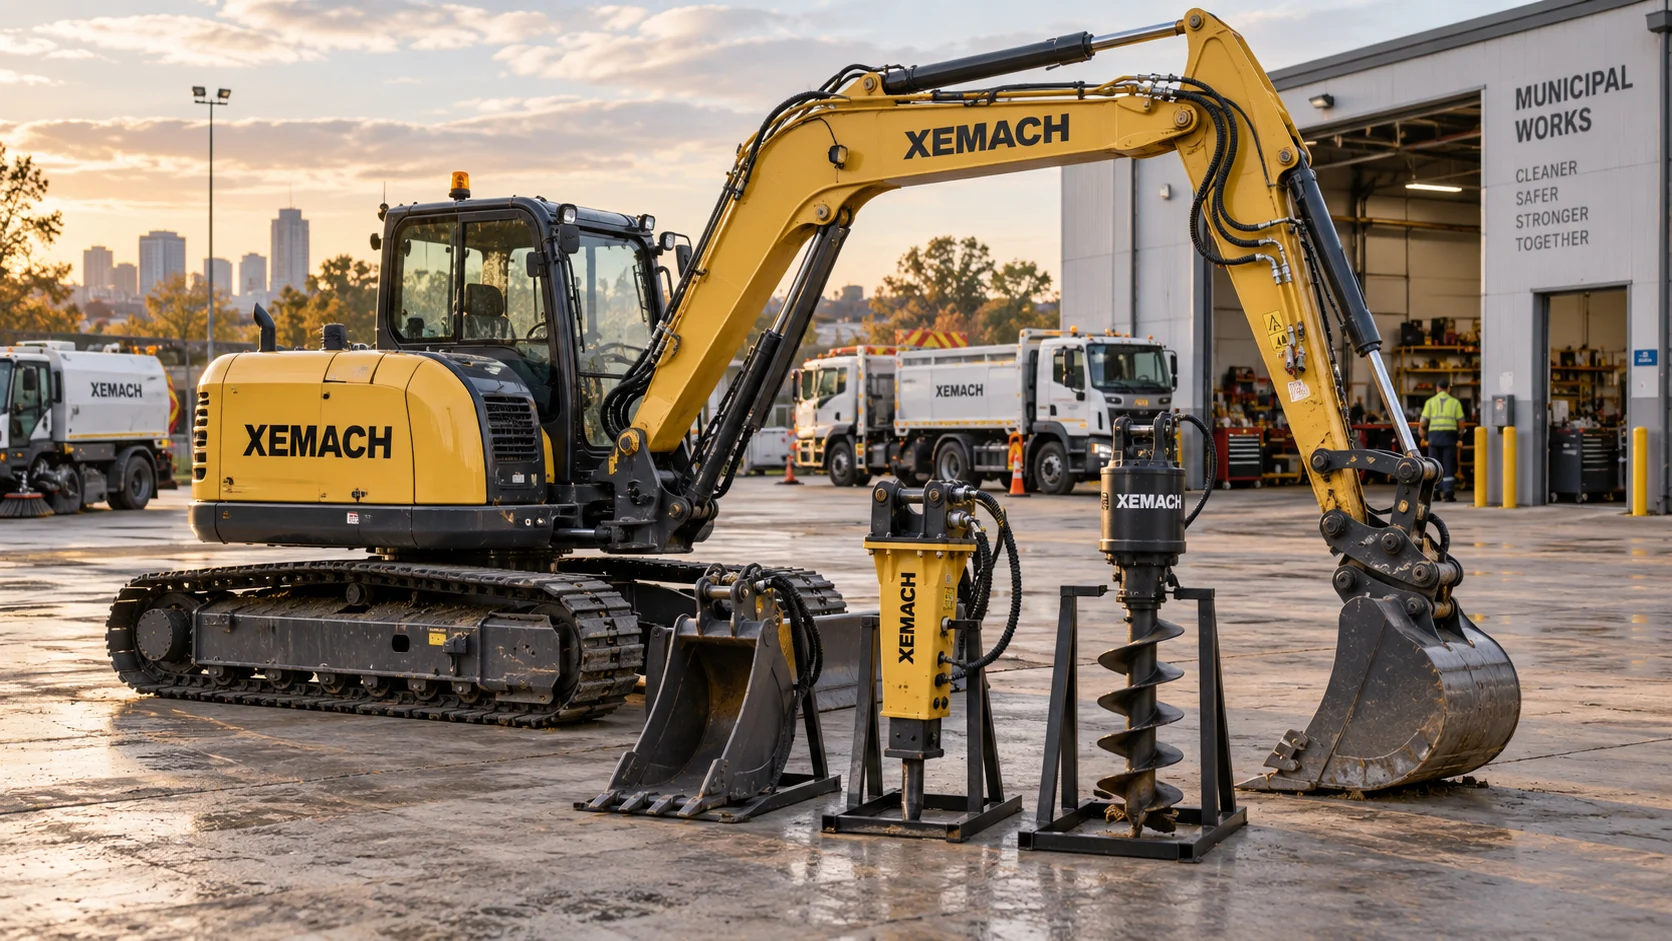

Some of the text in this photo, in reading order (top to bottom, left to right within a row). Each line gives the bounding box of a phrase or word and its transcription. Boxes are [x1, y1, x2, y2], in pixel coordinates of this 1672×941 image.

[1515, 65, 1632, 110] MUNICIPAL
[903, 114, 1069, 159] XEMACH
[1515, 107, 1592, 143] WORKS
[1516, 160, 1578, 183] CLEANER
[1516, 186, 1559, 206] SAFER
[1516, 206, 1589, 229] STRONGER
[1515, 230, 1589, 252] TOGETHER
[91, 381, 142, 398] XEMACH
[936, 383, 983, 398] XEMACH
[243, 424, 392, 459] XEMACH
[1116, 493, 1182, 510] XEMACH
[898, 572, 916, 664] XEMACH
